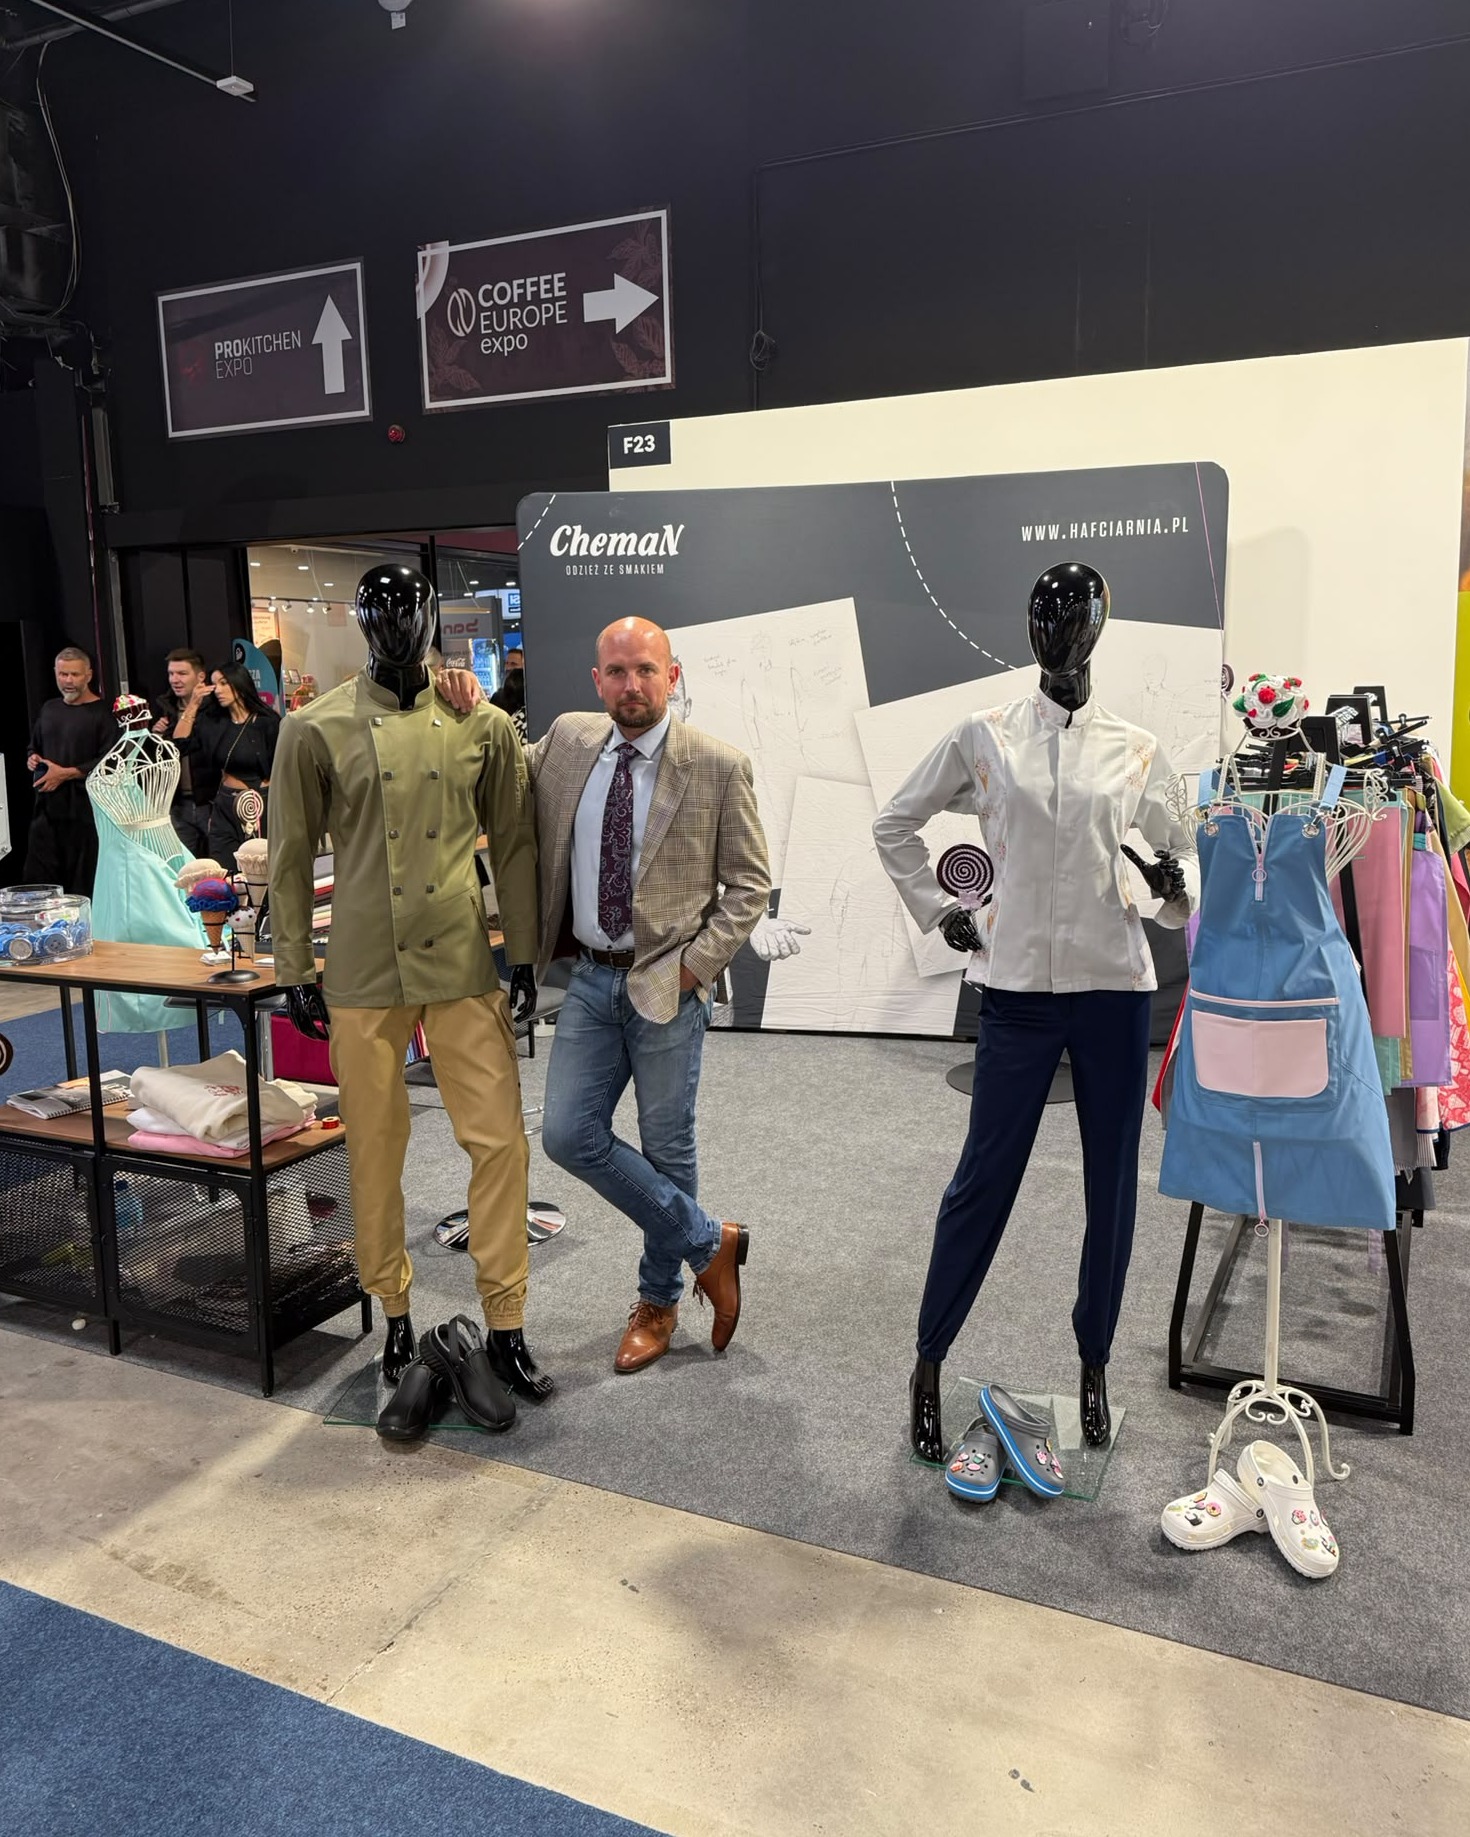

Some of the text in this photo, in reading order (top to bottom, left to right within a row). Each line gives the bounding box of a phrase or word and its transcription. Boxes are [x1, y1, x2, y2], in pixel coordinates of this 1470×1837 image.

[478, 272, 567, 308] COFFEE
[480, 300, 568, 334] EUROPE
[214, 329, 301, 360] PROKITCHEN
[480, 333, 528, 357] expo
[215, 356, 253, 379] EXPO
[623, 434, 656, 454] F23
[550, 523, 685, 557] ChemaN
[1021, 516, 1189, 541] WWW.HAFCIARNIA.PL
[603, 564, 615, 575] ZE
[619, 563, 665, 575] SMAKIEM
